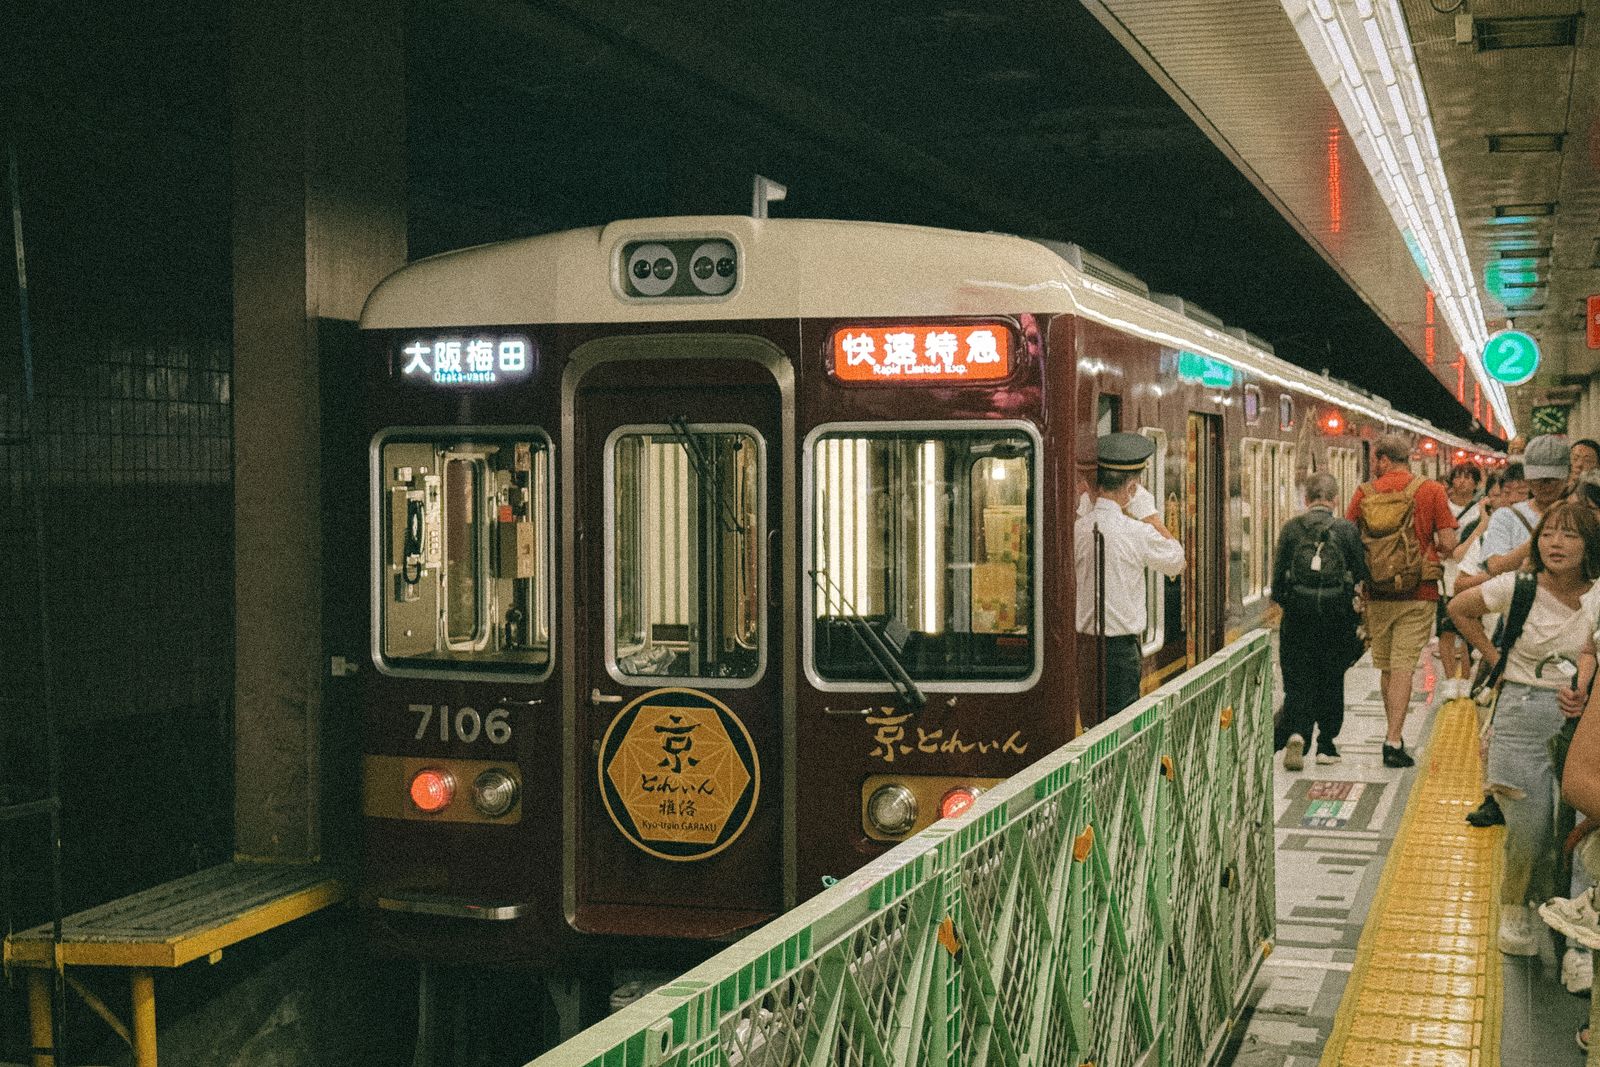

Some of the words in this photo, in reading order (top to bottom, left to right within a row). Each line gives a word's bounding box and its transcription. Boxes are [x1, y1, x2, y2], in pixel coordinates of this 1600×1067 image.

[403, 340, 525, 373] 大阪梅田
[842, 330, 1000, 366] 快速特急
[1497, 339, 1523, 374] 2
[408, 704, 512, 744] 7106
[865, 706, 1028, 762] 京とれいん
[654, 714, 701, 774] 京
[643, 774, 714, 795] とれいん
[658, 799, 697, 817] 雅洛
[642, 820, 680, 830] Kyo-train
[681, 821, 717, 832] GARAKU
